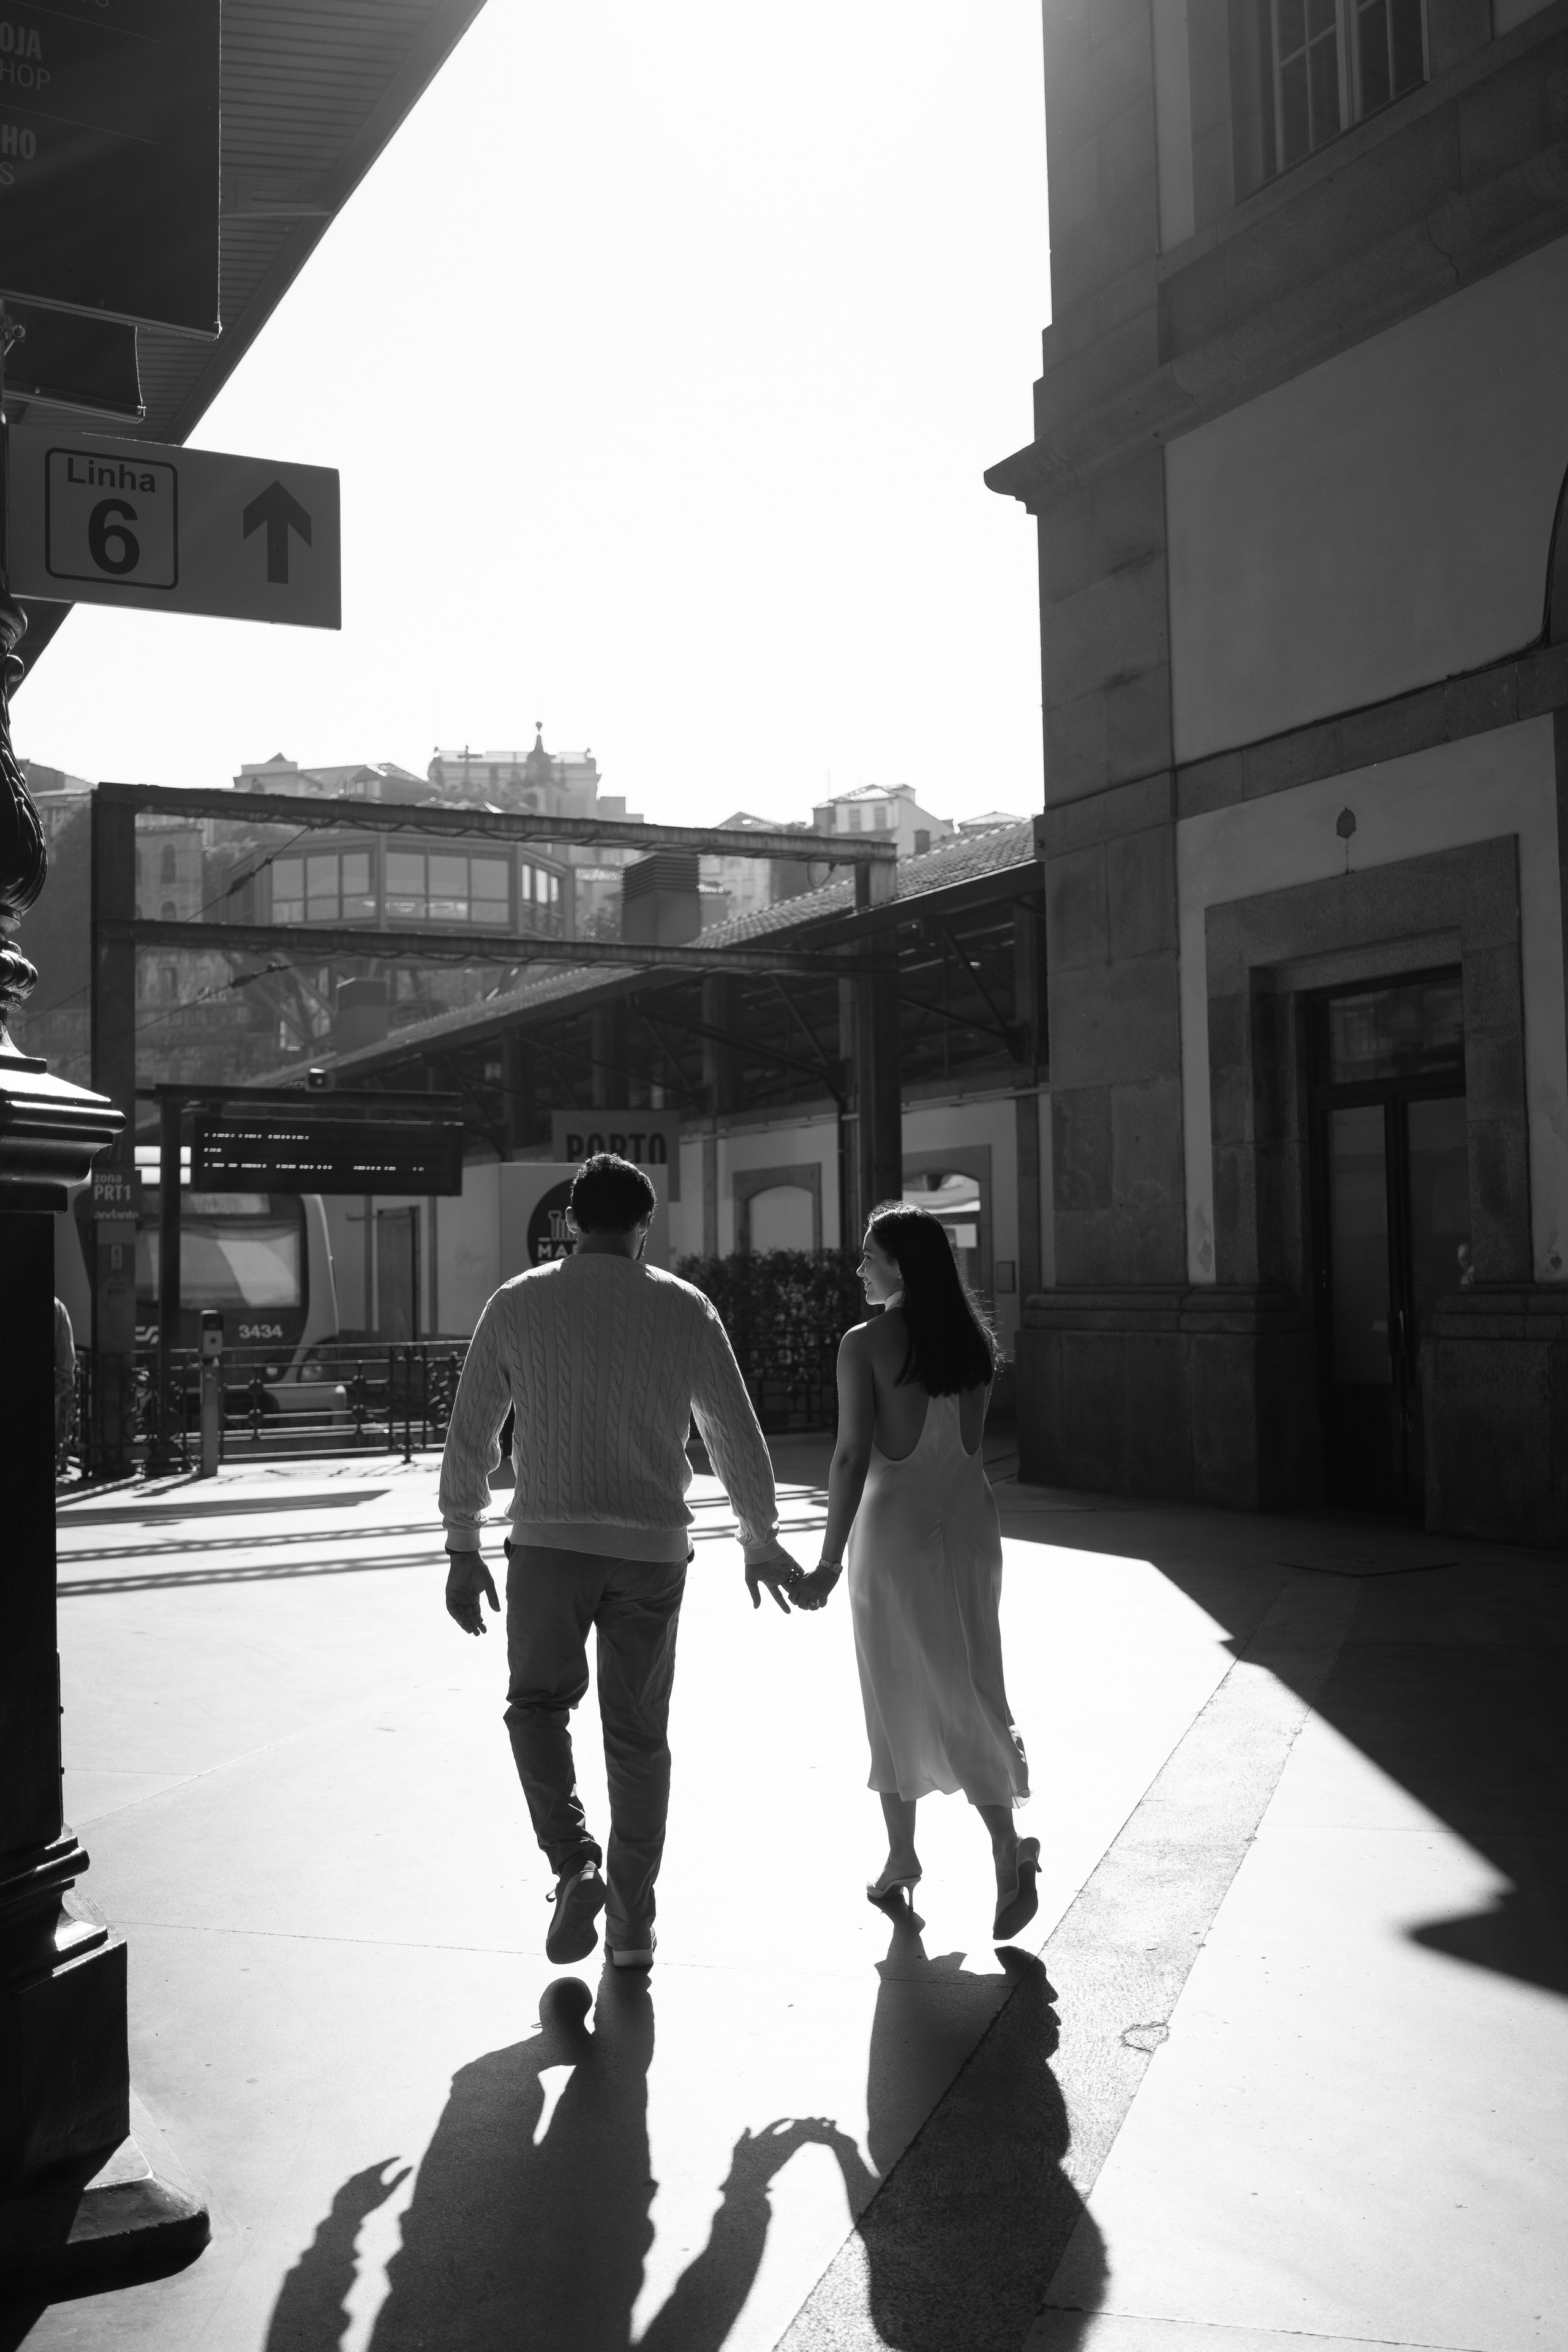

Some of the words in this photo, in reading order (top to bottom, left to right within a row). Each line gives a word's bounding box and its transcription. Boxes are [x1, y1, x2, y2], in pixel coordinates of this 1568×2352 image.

[67, 457, 156, 493] Linha
[88, 498, 140, 575] 6
[567, 1133, 667, 1163] PORTO
[94, 1174, 123, 1184] zona
[94, 1183, 131, 1202] PRT1
[94, 1208, 140, 1220] andante
[238, 1324, 284, 1340] 3434
